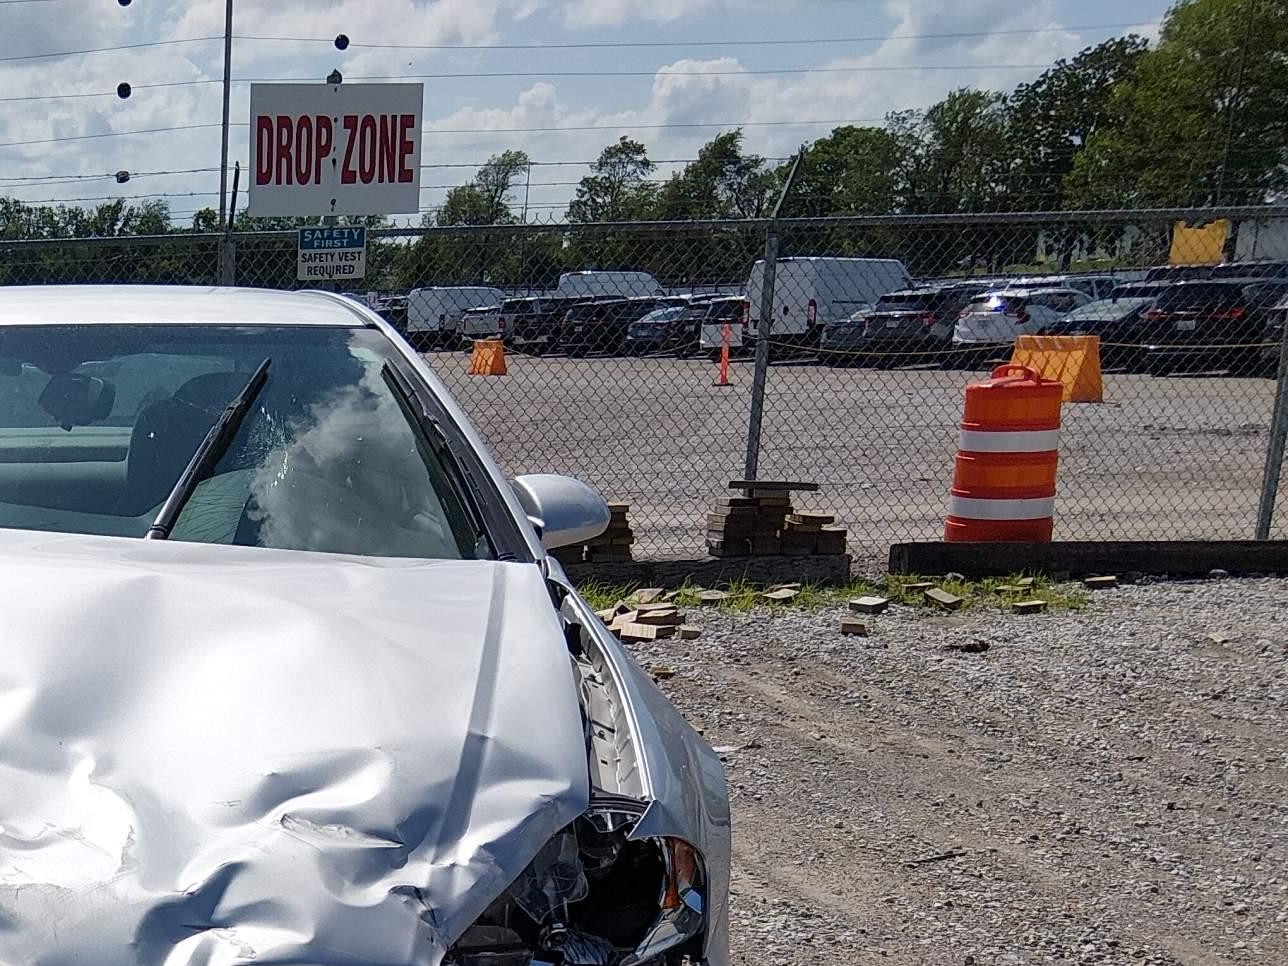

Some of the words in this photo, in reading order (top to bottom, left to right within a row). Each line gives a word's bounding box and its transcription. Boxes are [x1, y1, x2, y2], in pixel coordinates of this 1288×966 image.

[256, 114, 333, 186] DROP
[341, 114, 416, 185] ZONE
[304, 229, 361, 242] SAFETY
[314, 239, 350, 248] FIRST
[302, 252, 336, 263] SAFETY
[338, 251, 362, 262] VEST
[307, 264, 355, 277] REQUIRED
